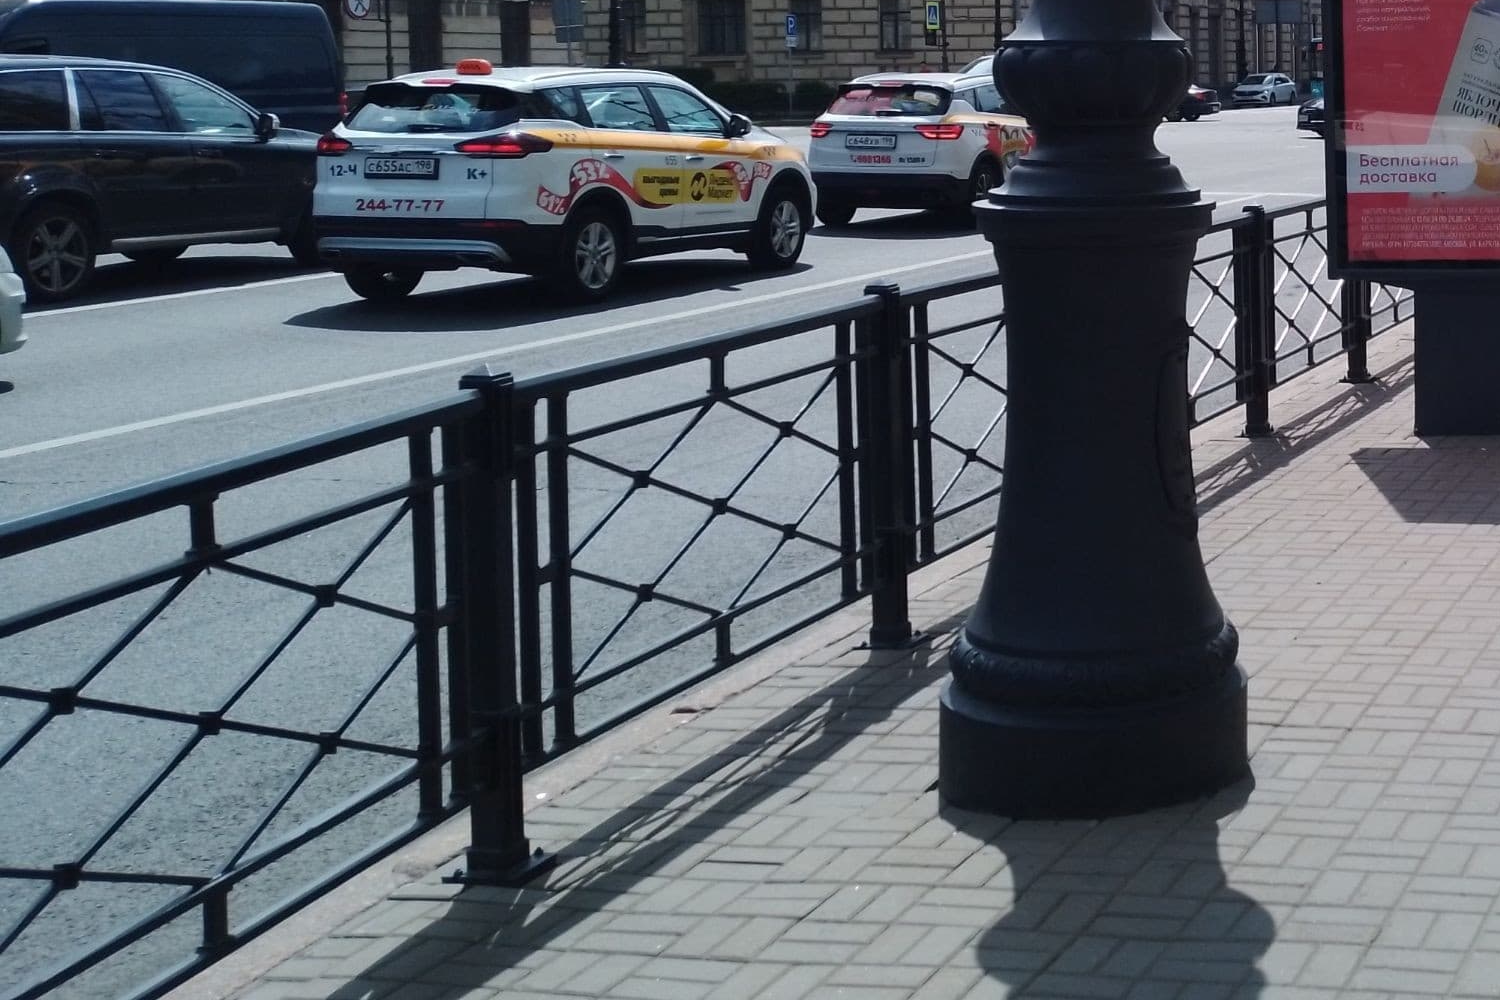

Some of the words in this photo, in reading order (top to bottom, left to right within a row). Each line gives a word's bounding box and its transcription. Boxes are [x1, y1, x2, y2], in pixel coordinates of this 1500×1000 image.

[367, 160, 412, 173] С655АС
[414, 160, 433, 170] 198
[1360, 153, 1459, 167] Бесплатная
[1360, 172, 1437, 185] доставка
[356, 199, 445, 212] 244-77-77
